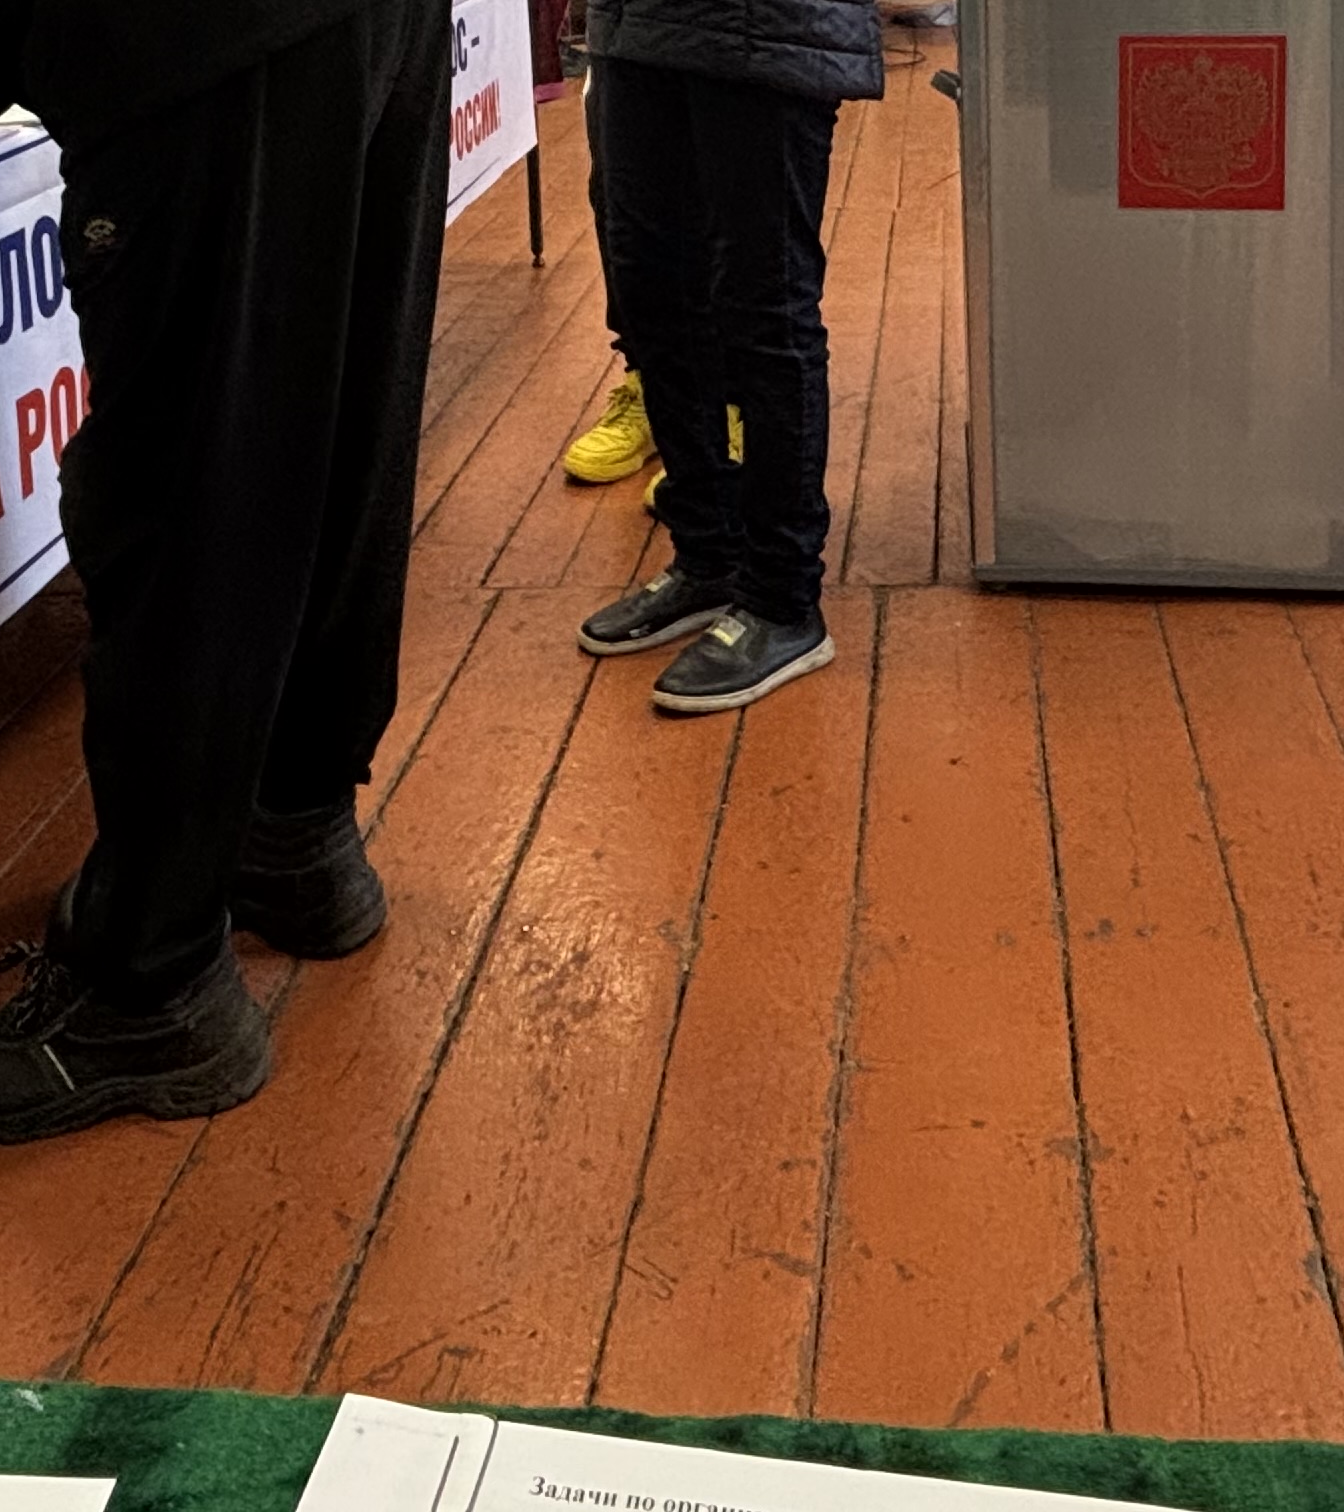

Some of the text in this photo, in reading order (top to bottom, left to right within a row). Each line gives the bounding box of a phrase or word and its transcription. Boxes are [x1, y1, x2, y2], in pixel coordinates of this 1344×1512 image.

[16, 363, 91, 500] РО
[529, 1476, 753, 1512] Задачи по орга
